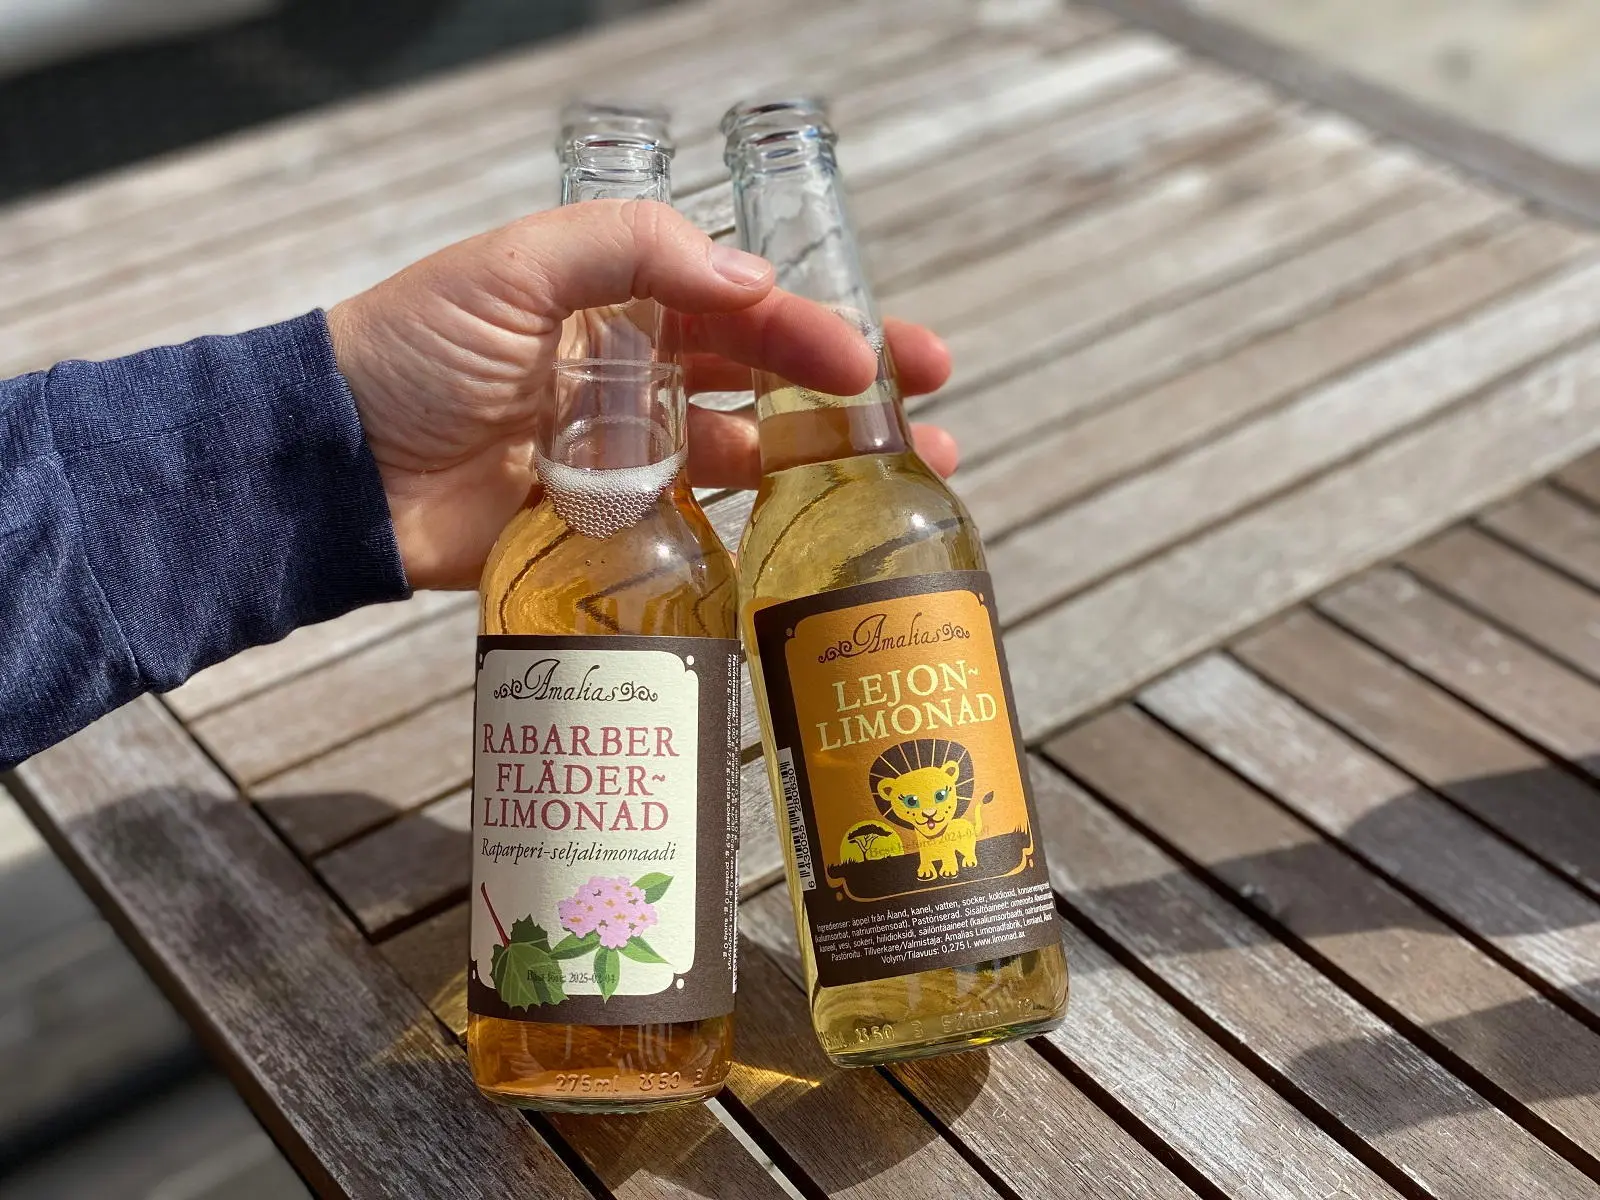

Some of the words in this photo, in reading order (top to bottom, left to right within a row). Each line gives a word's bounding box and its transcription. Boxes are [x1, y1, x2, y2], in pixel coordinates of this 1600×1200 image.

[853, 611, 942, 654] Amalias
[519, 658, 619, 702] Amalias
[816, 692, 998, 752] LIMONAD
[482, 722, 680, 757] RABARBER
[483, 797, 669, 832] LIMONAD
[481, 837, 677, 867] Raparperi-seljalimonaadi
[871, 914, 886, 922] från
[887, 908, 909, 920] Åland,
[911, 904, 934, 915] kanel,
[935, 901, 960, 911] vatten,
[962, 896, 988, 906] socker,
[912, 910, 962, 926] Pastöriserad.
[965, 901, 1009, 916] Sisältöaineet:
[864, 936, 943, 956] Tillverkare/Valmistaja:
[945, 930, 974, 942] Amalias
[975, 920, 1022, 936] Limonadfabrik,
[919, 919, 968, 936] säilöntäaineet
[881, 948, 940, 964] Volym/Tilavuus:
[942, 941, 965, 954] 0,275
[973, 931, 1025, 948] www.limonad.ax
[556, 1074, 619, 1092] 275ml
